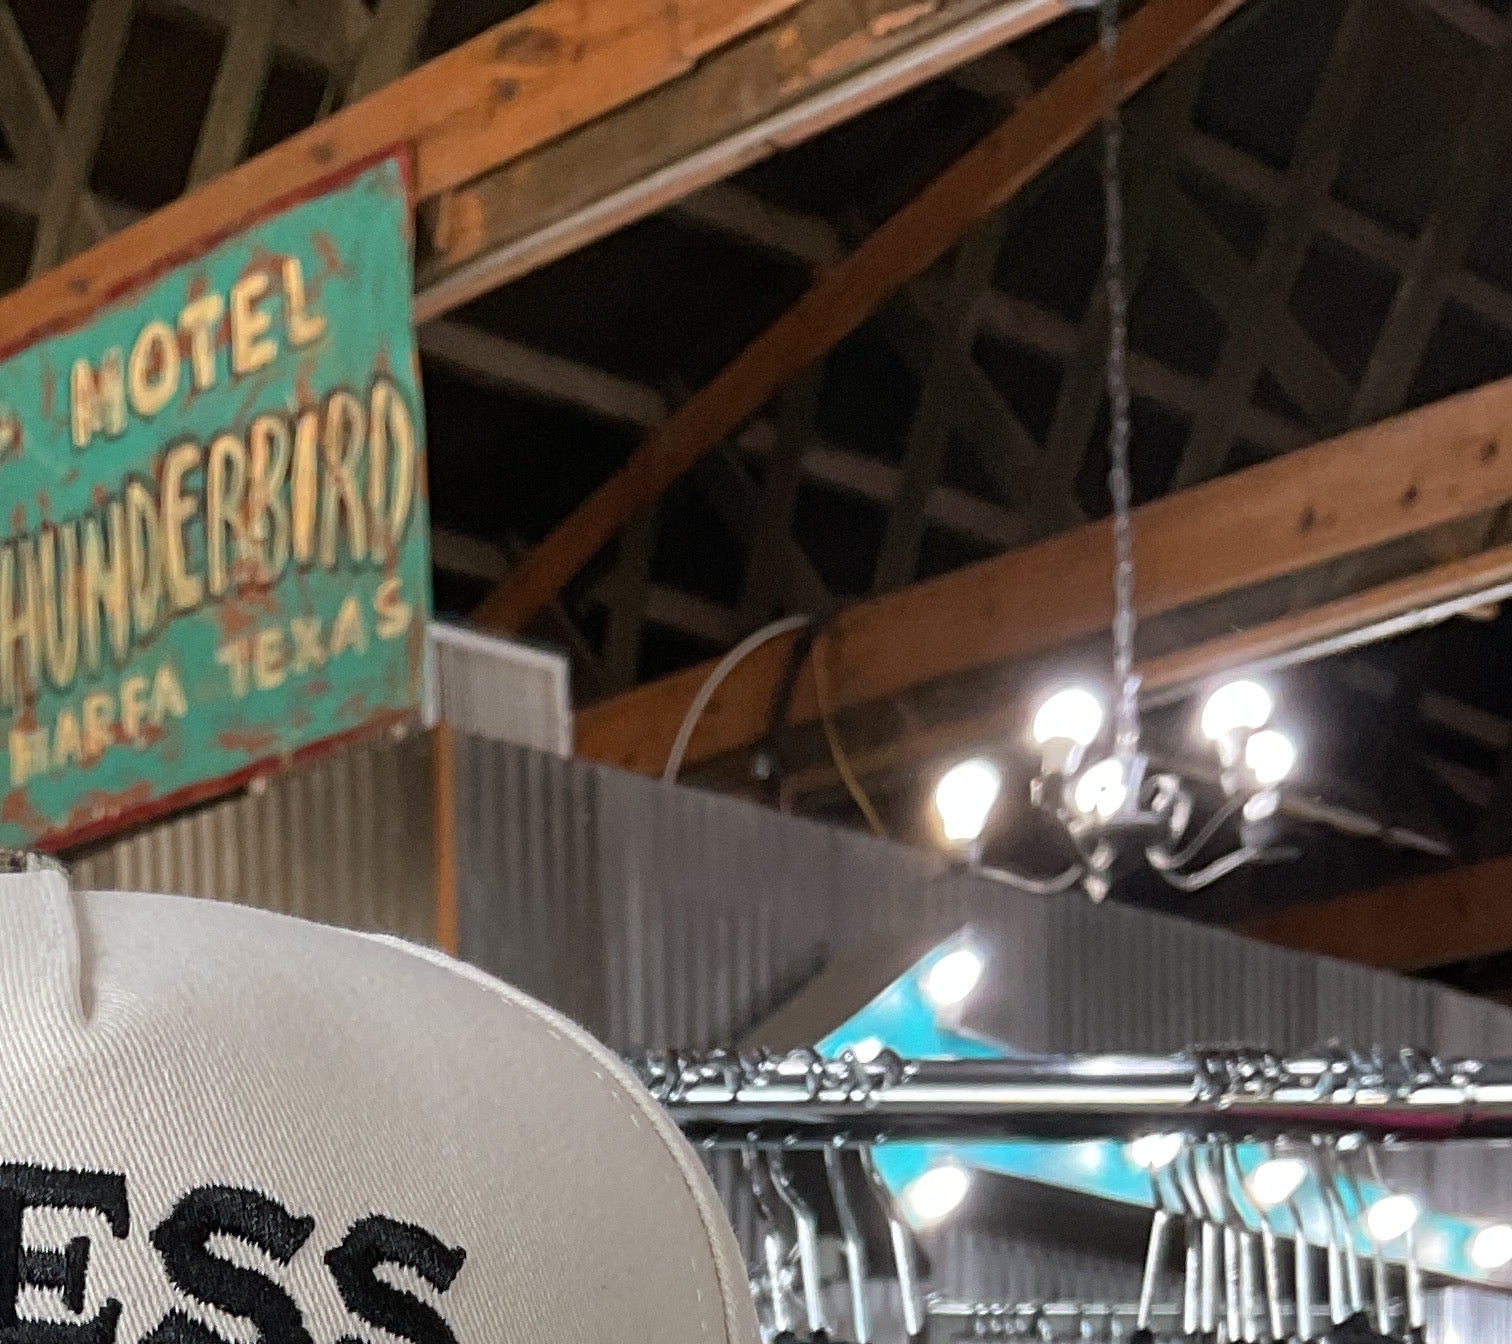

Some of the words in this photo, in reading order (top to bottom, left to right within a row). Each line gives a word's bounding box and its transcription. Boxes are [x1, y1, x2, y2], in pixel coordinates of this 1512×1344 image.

[69, 257, 327, 447] MOTEL
[8, 661, 188, 786] MARFA
[217, 581, 412, 698] TEXAS
